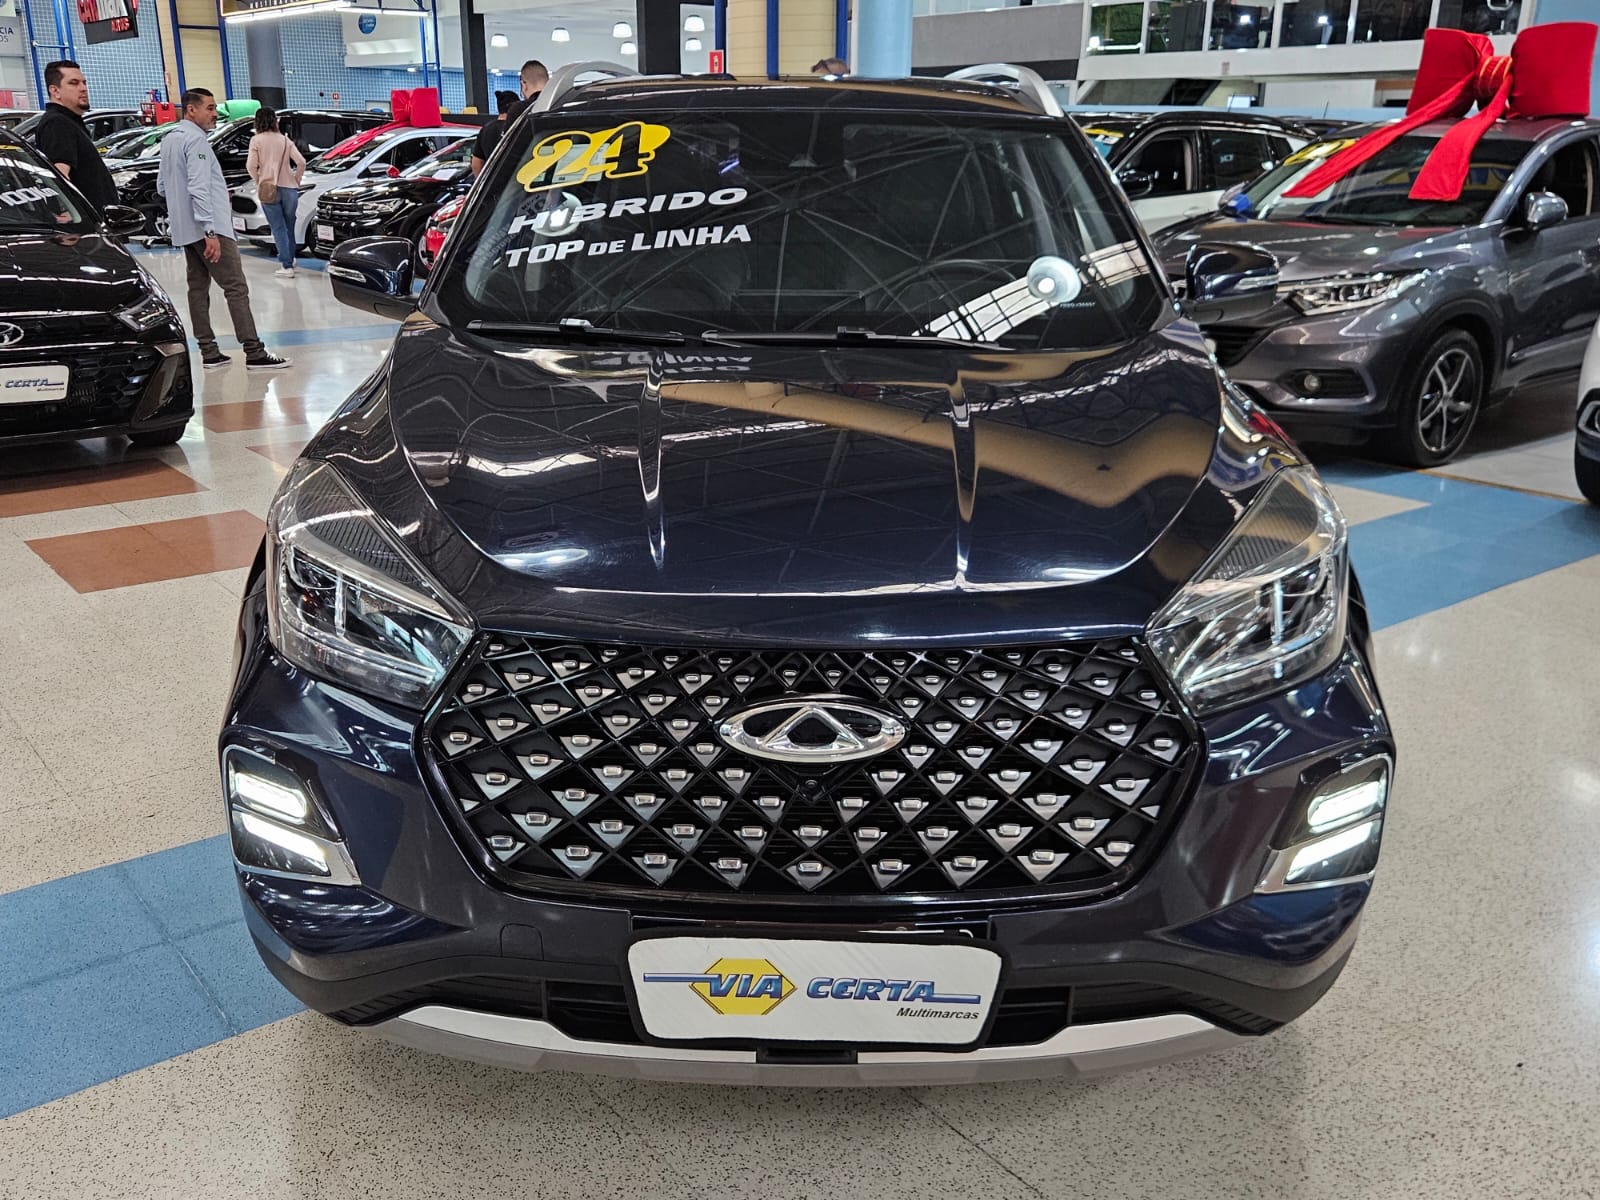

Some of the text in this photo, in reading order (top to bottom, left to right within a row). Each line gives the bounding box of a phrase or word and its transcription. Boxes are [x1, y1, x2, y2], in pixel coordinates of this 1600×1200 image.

[517, 121, 671, 192] 24
[505, 240, 585, 268] TOP
[587, 240, 626, 256] DE
[631, 224, 752, 251] LINHA
[706, 973, 935, 1001] VIA CERTA
[896, 1007, 980, 1021] Multimarcas
